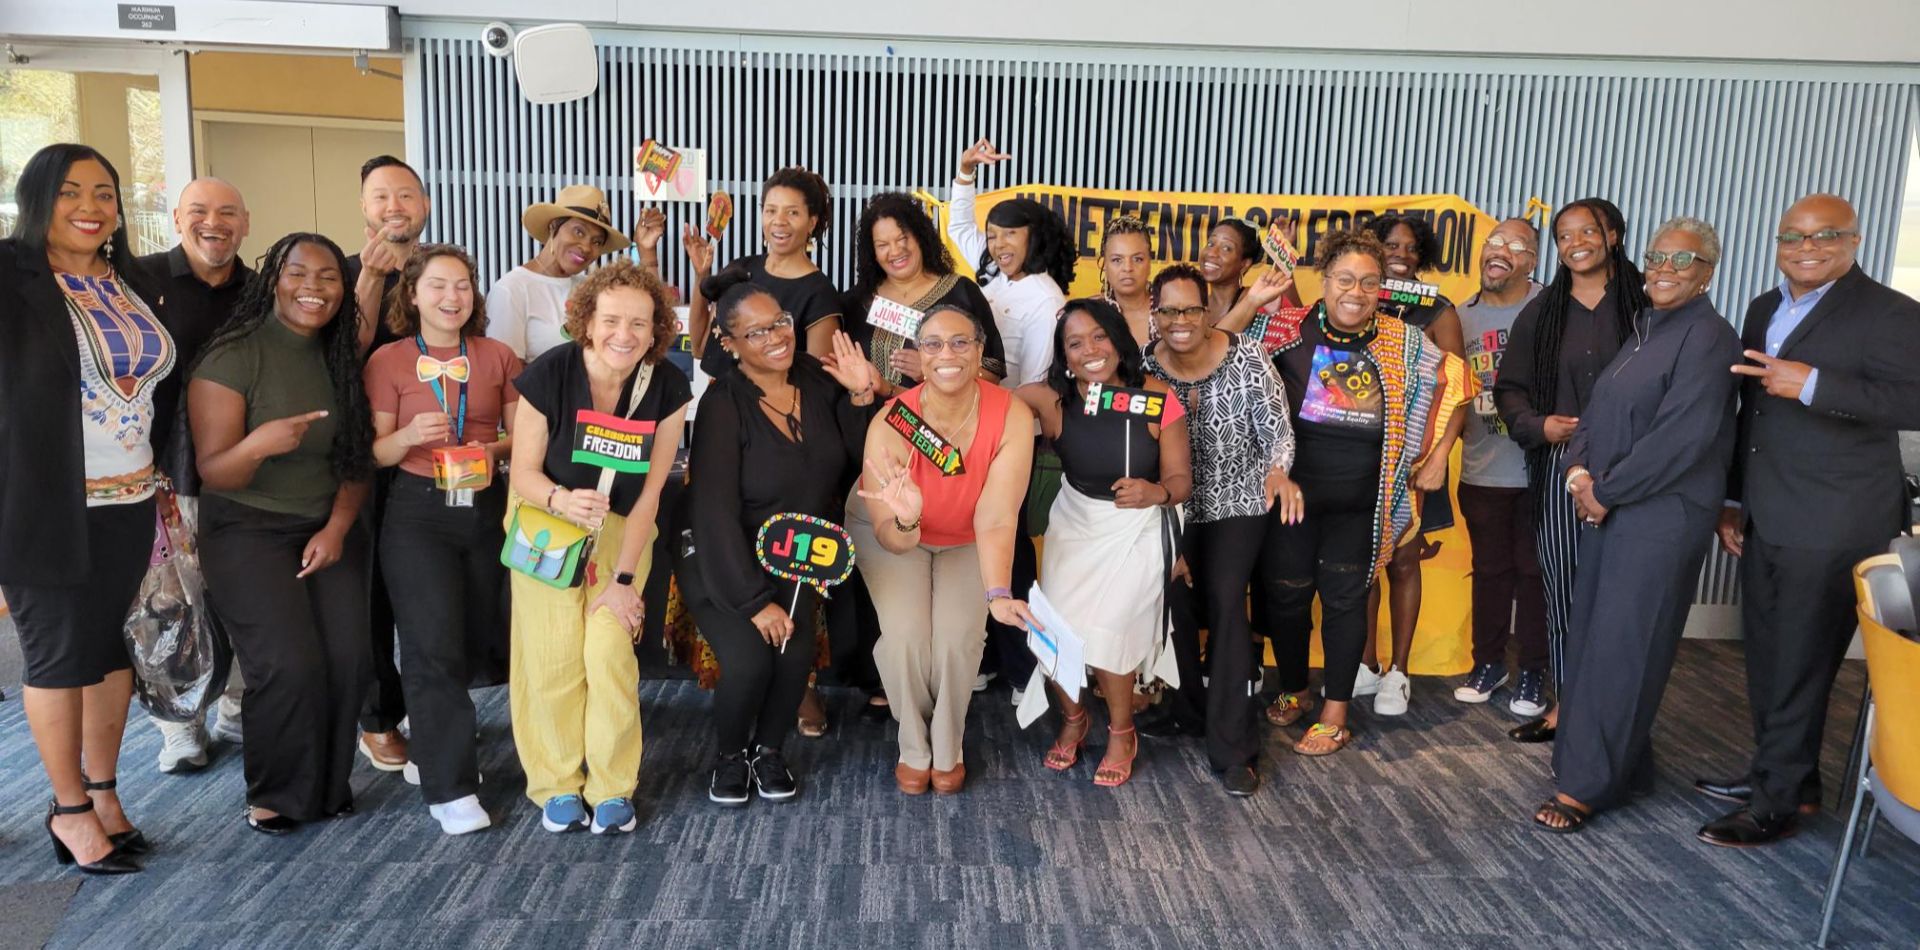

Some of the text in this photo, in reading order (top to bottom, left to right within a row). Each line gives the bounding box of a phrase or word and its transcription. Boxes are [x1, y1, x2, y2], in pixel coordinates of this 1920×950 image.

[128, 13, 164, 21] OCCUPANCY
[131, 6, 161, 14] MAXIMUM
[1380, 279, 1439, 298] LEBRATE
[1378, 289, 1436, 308] EEDOM DAY
[1101, 390, 1163, 416] 1865
[586, 425, 644, 444] CELEBRATE
[888, 413, 947, 467] JUNETEENTH
[582, 435, 642, 461] FREEDOM
[772, 528, 839, 567] J19
